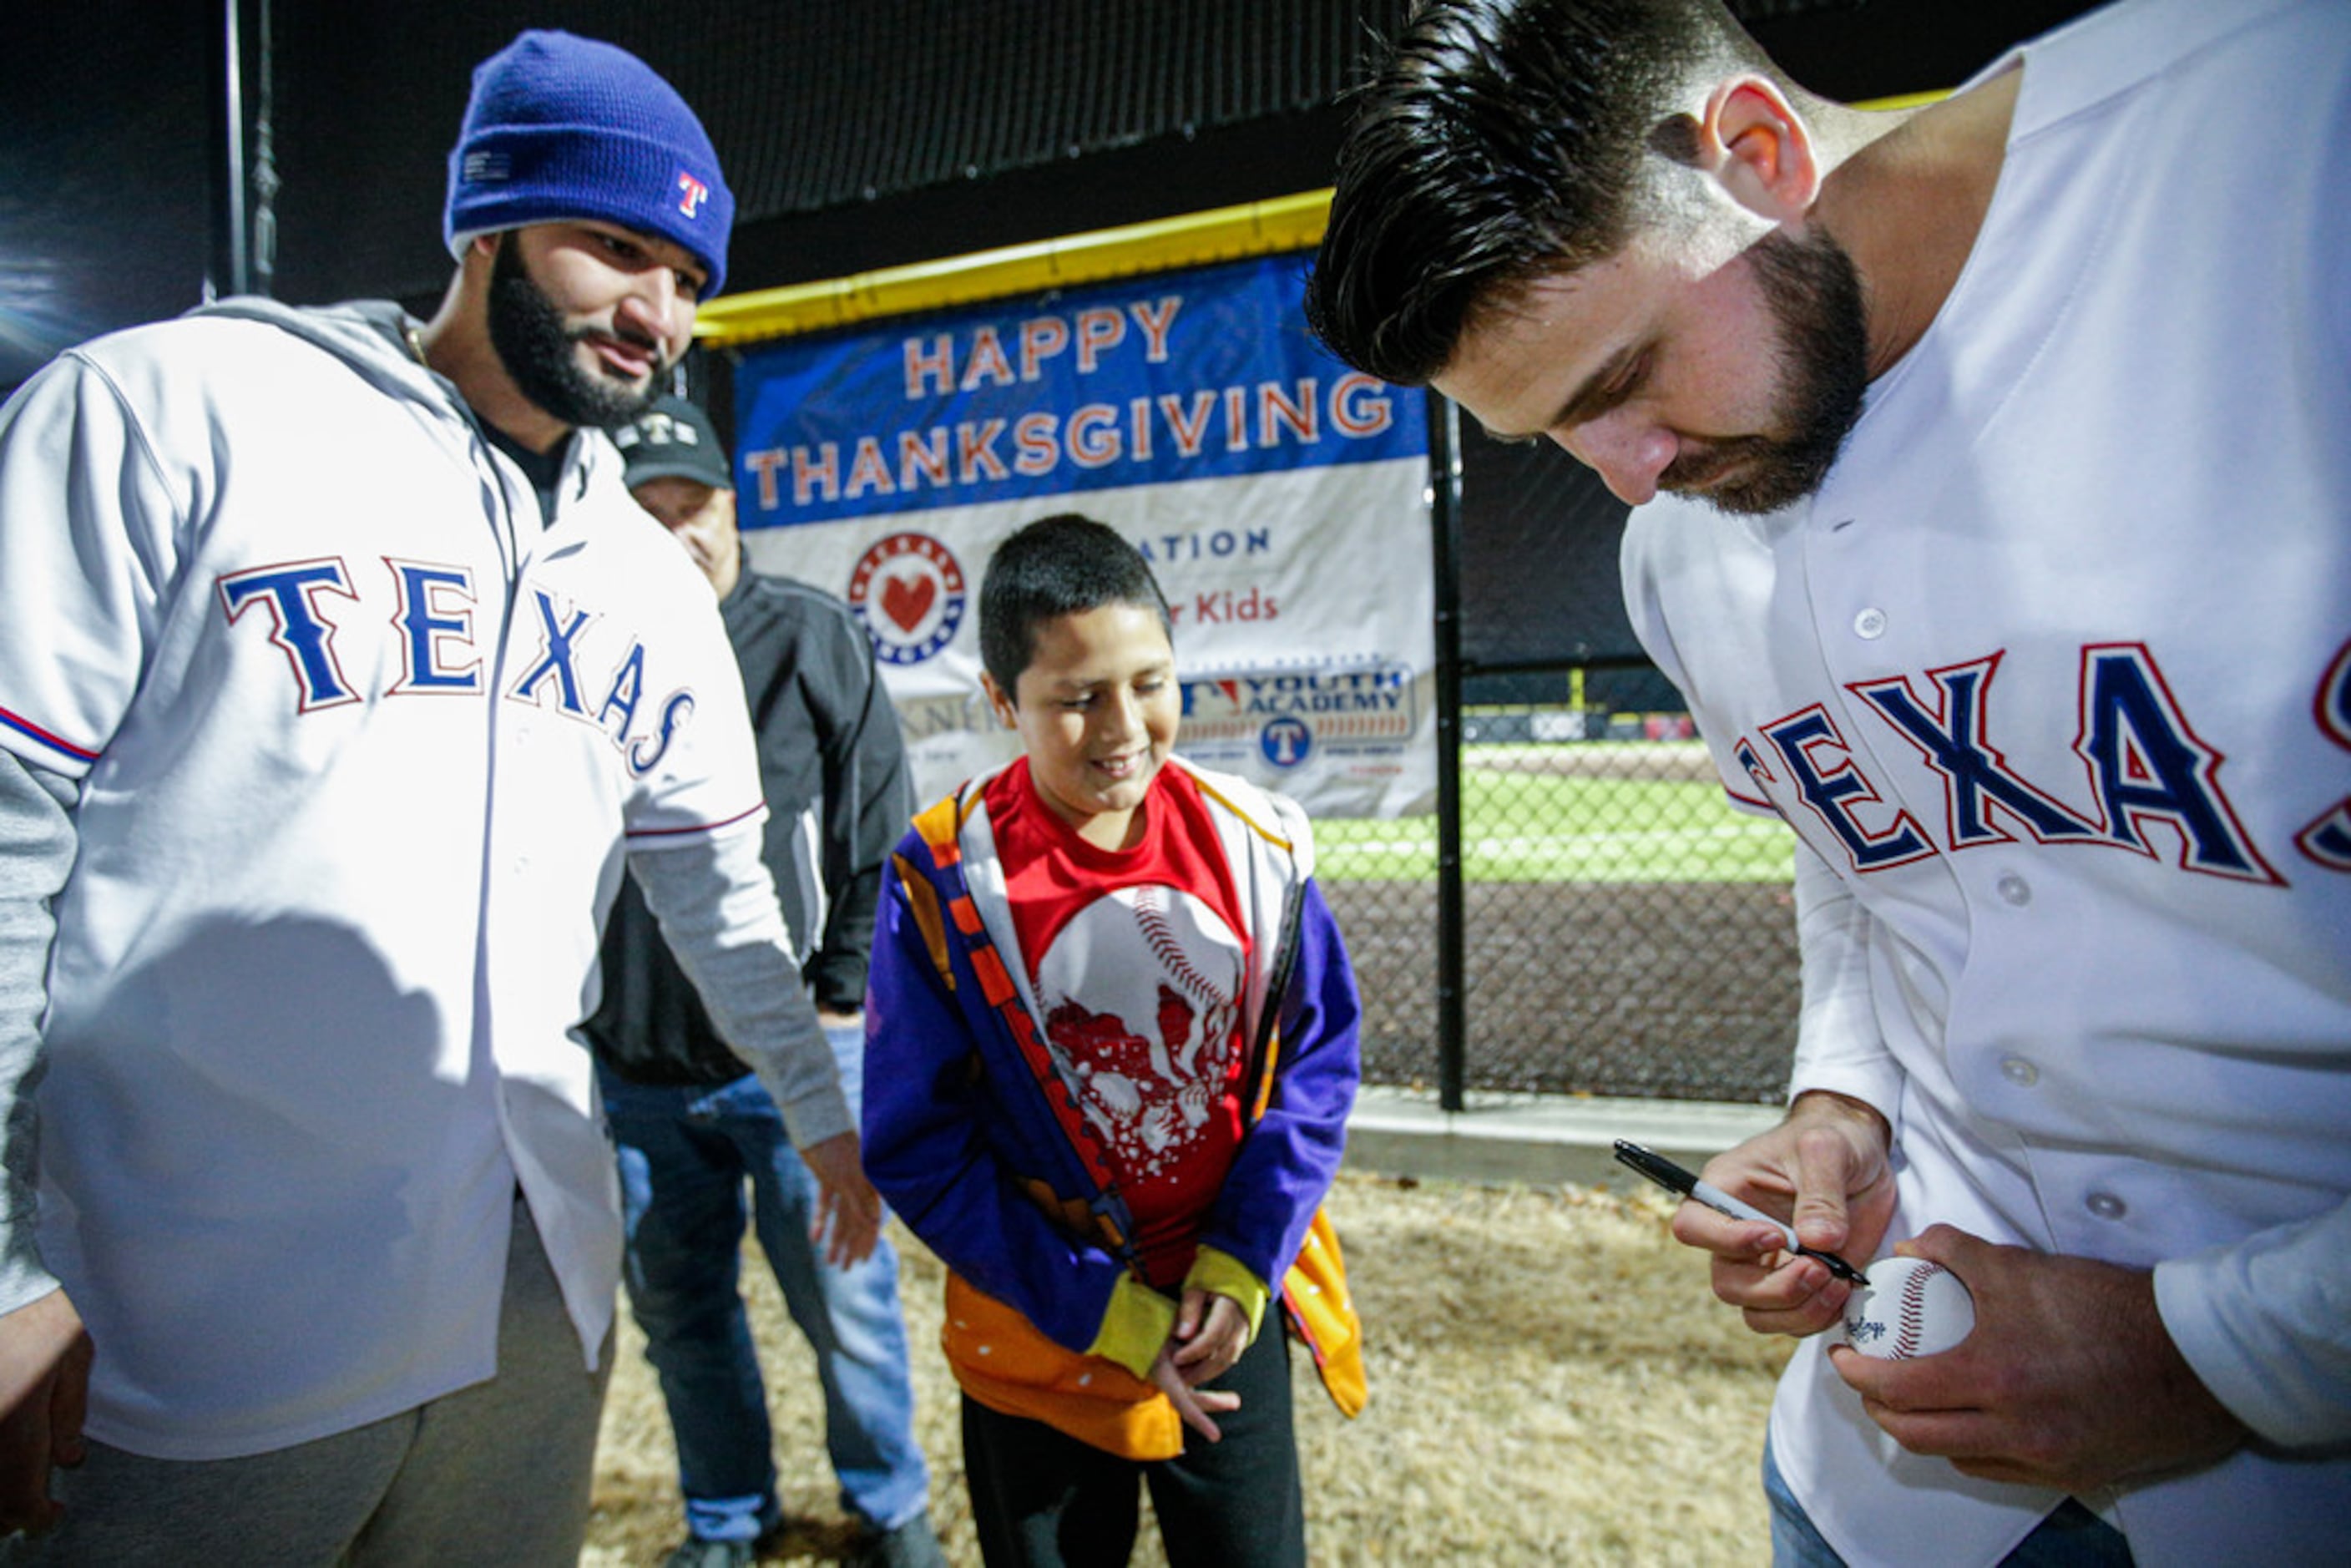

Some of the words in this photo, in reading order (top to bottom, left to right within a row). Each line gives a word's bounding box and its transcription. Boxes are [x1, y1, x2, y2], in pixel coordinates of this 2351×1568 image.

[679, 172, 708, 219] T
[903, 294, 1182, 401] HAPPY
[745, 371, 1393, 511] THANKSGIVING
[1196, 586, 1280, 623] Kids
[216, 555, 695, 780] TEXAS
[1246, 691, 1400, 713] ACADEMY
